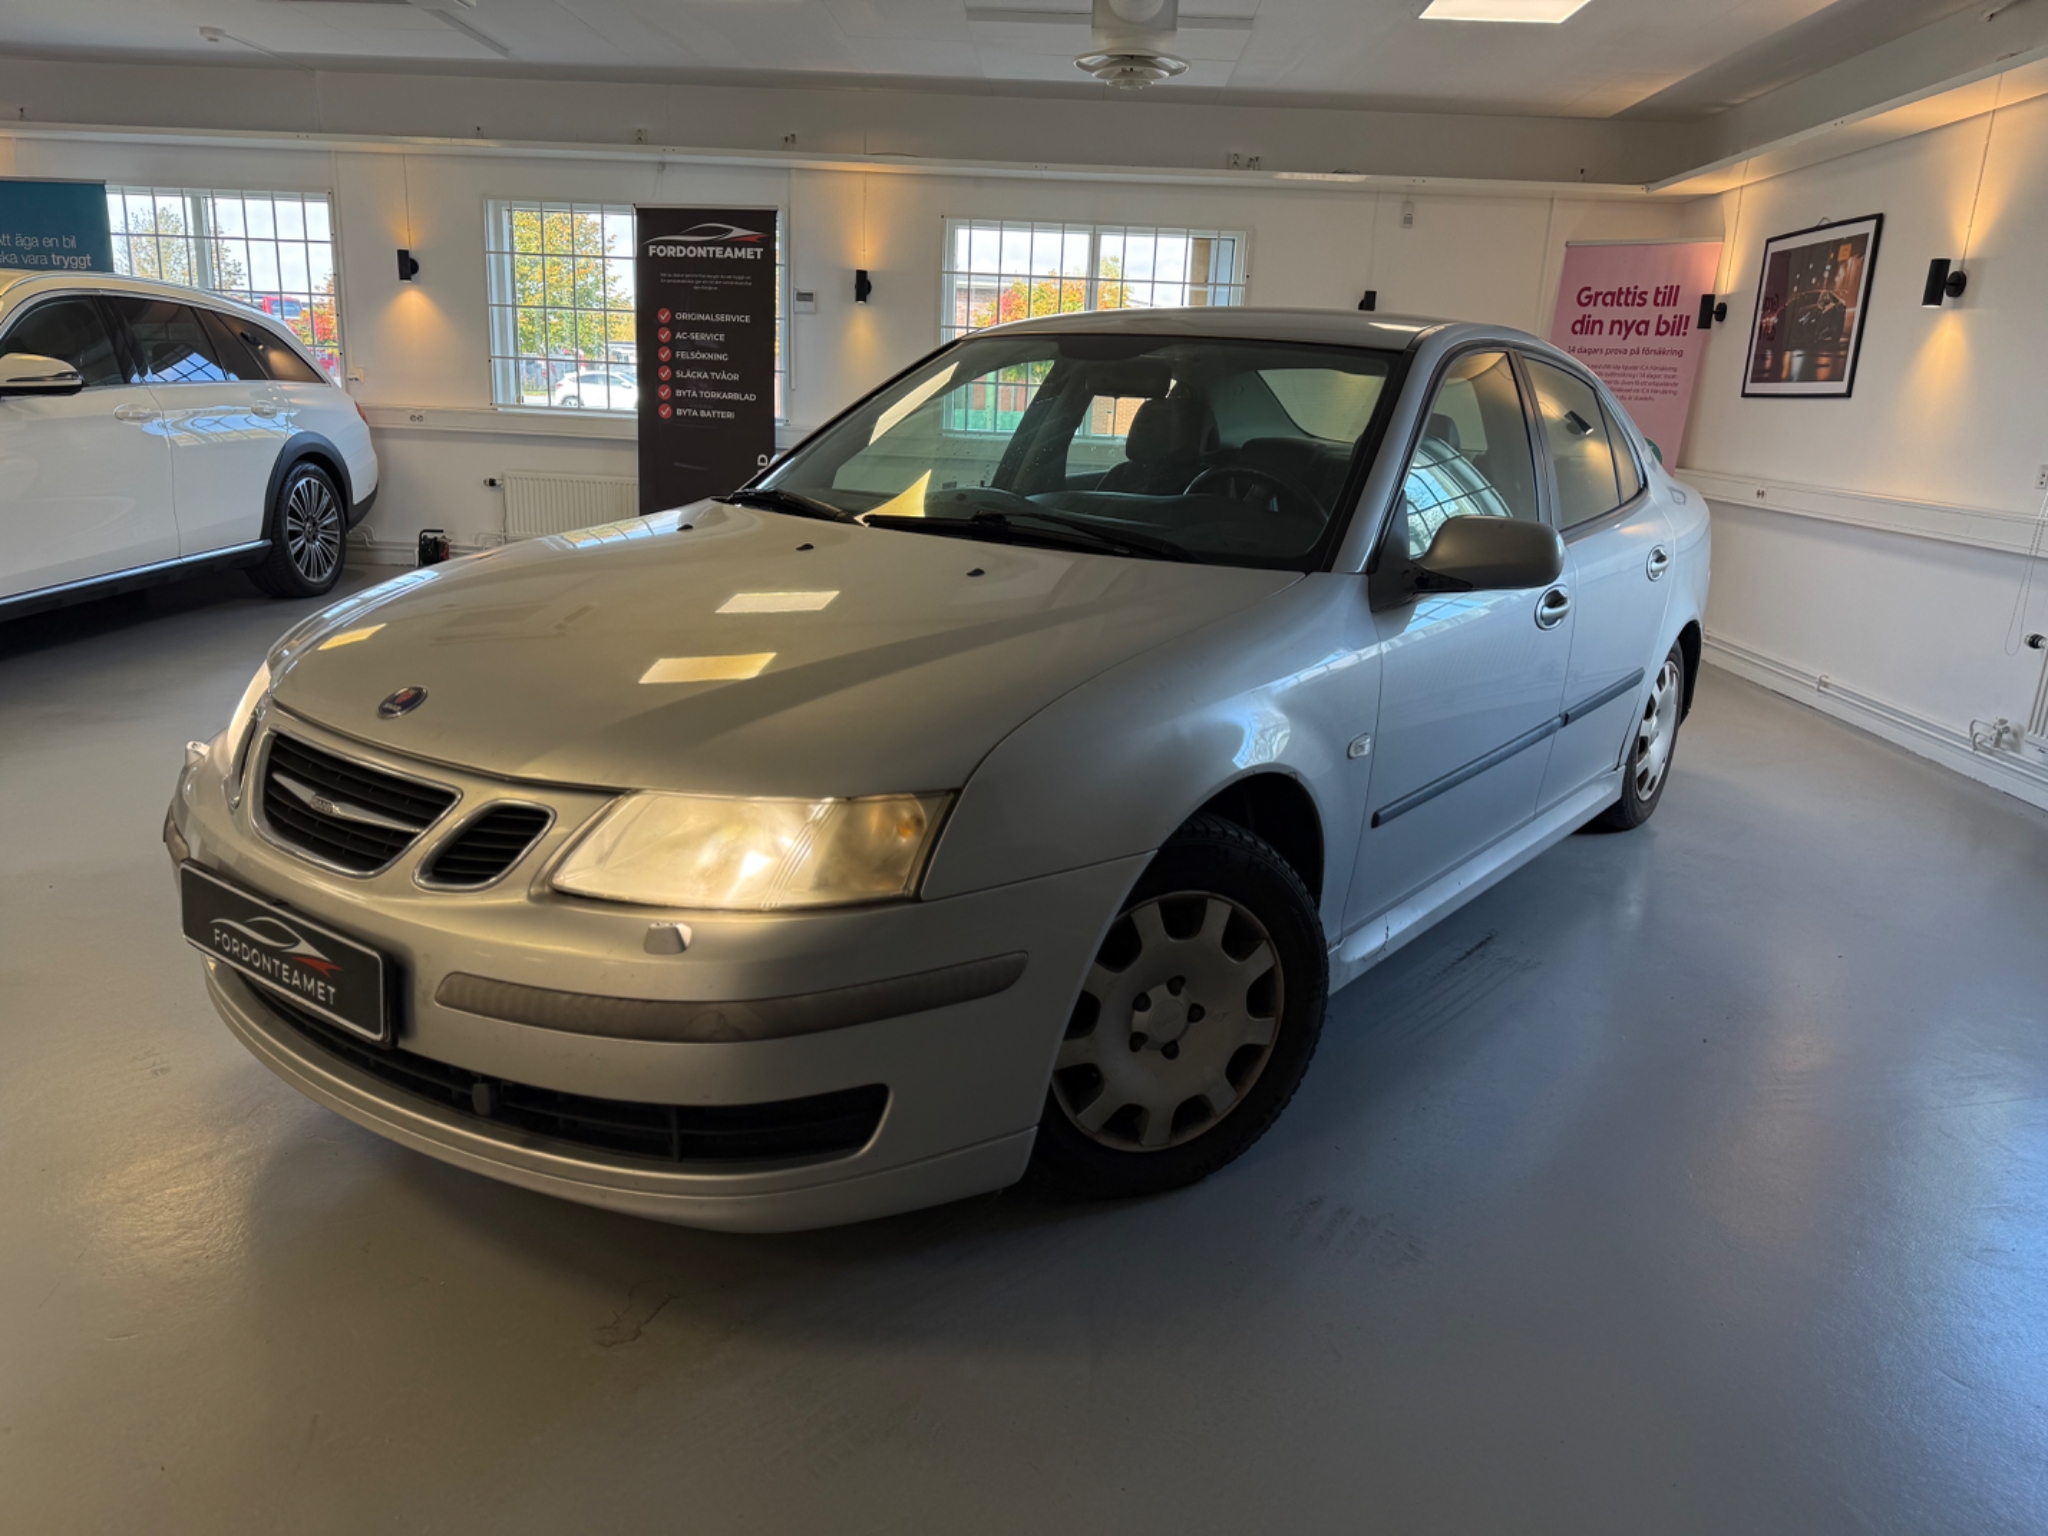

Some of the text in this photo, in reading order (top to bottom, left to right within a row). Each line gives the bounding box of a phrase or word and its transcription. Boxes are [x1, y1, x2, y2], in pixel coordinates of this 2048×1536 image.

[0, 233, 77, 250] tt äga en bil
[648, 244, 764, 259] FORDONTEAMET
[21, 253, 48, 265] vara
[50, 252, 92, 269] tryggt
[1576, 284, 1681, 307] Grattis till
[675, 311, 751, 323] ORIGINALSERVICE
[1570, 313, 1691, 341] din nya bil!
[675, 331, 725, 342] AC-SERVICE
[675, 350, 729, 361] FELSÖKNING
[1577, 345, 1604, 356] dagars
[1605, 346, 1629, 356] prova
[1629, 345, 1640, 356] på
[1641, 346, 1684, 358] försäkring
[710, 369, 740, 381] TVÅOR
[675, 388, 757, 401] BYTA TORKARBLAD
[676, 408, 736, 419] BYTA BATTERI
[214, 928, 337, 1005] FORDONTEAMET
